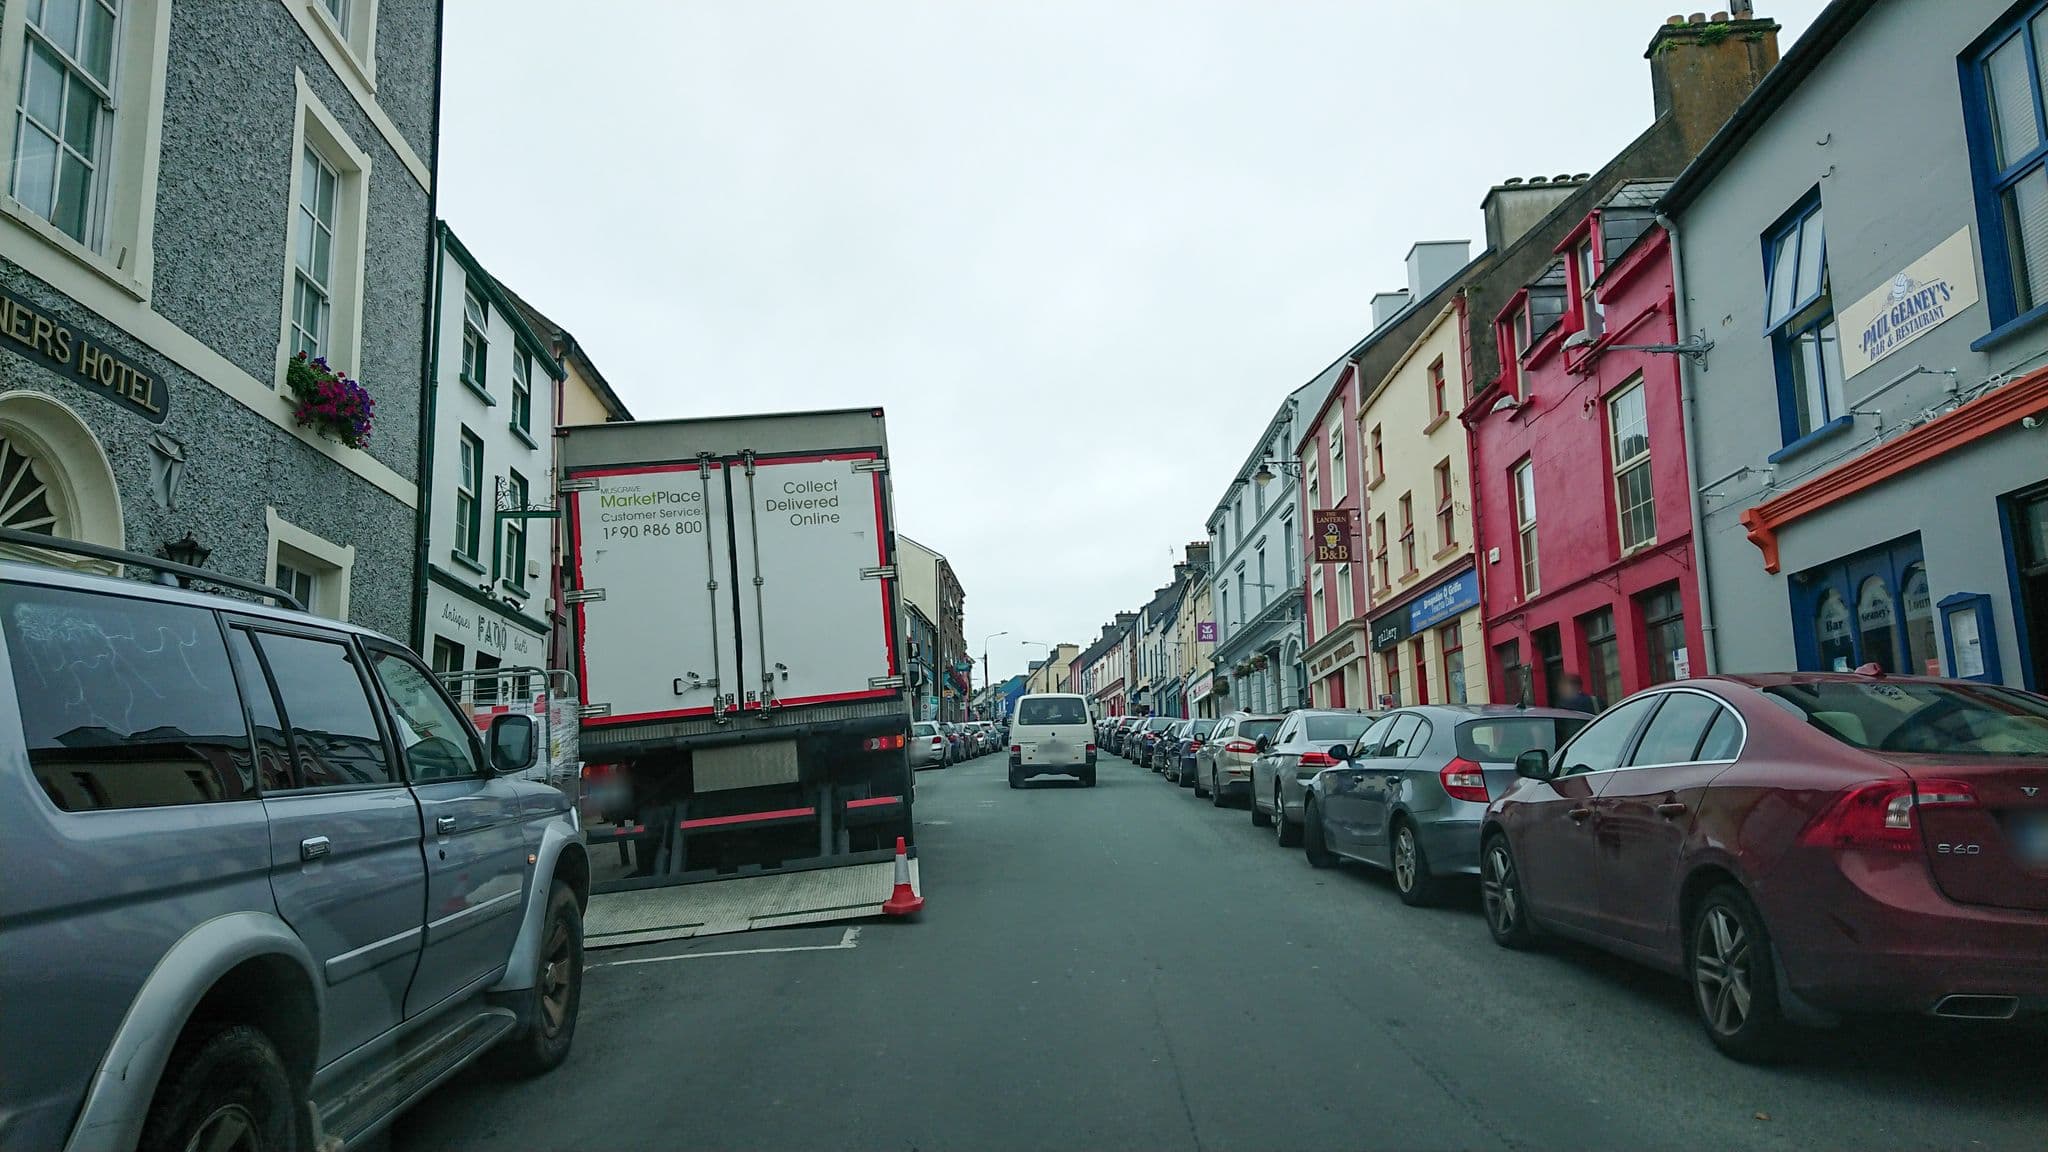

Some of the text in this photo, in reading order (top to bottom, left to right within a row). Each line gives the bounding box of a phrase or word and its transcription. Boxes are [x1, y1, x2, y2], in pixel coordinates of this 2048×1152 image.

[1863, 282, 1950, 352] PAUL GEANEY'S
[1871, 340, 1885, 361] BAR
[1895, 305, 1945, 342] RESTAURANT
[79, 340, 160, 414] HOTEL
[600, 486, 641, 495] MUSGRAVE
[783, 480, 838, 494] Collect
[601, 491, 701, 508] MarketPlace
[766, 495, 839, 512] Delivered
[601, 511, 656, 523] Customer
[790, 512, 840, 527] Online
[1316, 516, 1346, 524] LANTERN
[675, 520, 702, 535] 800
[1319, 545, 1349, 560] B&B
[1826, 620, 1843, 632] Bar
[1937, 843, 1980, 855] S60
